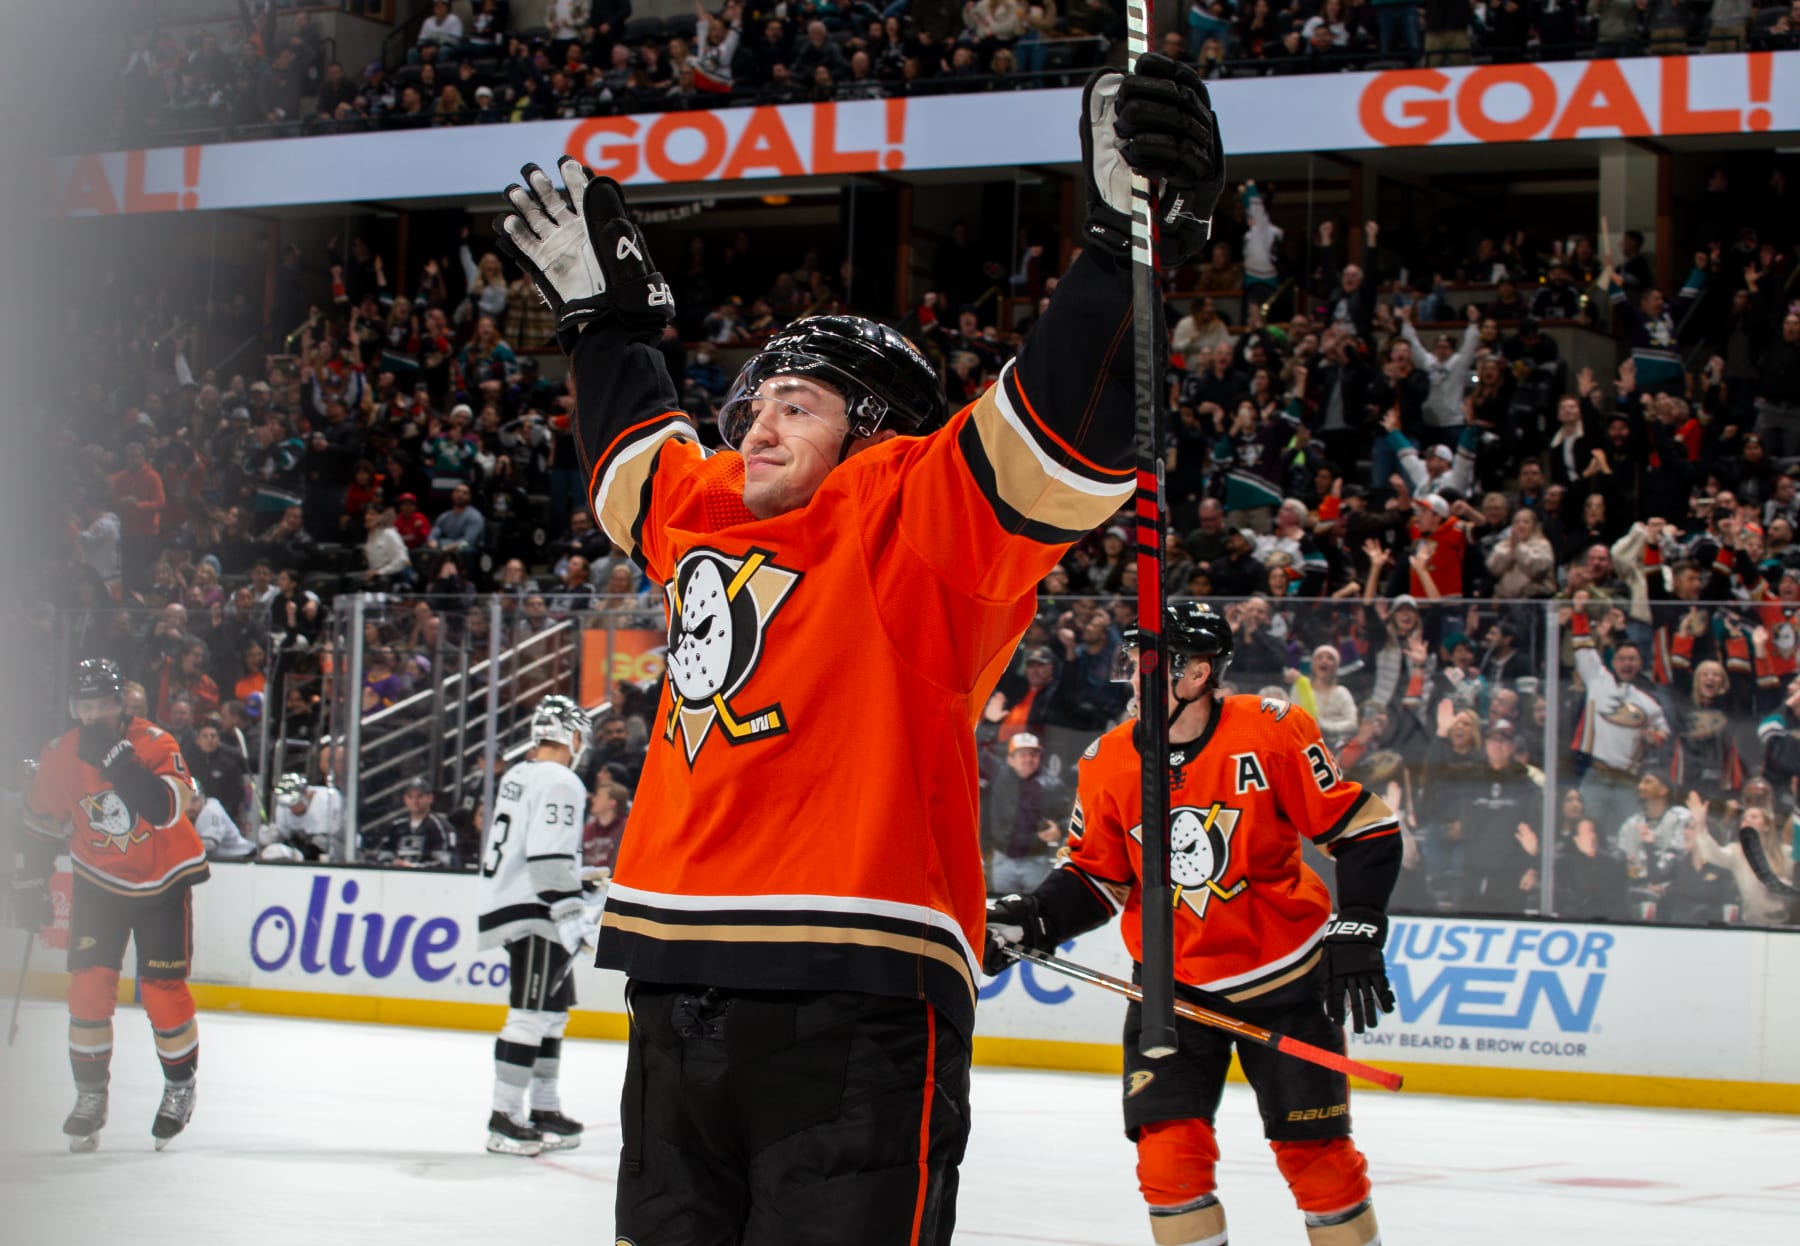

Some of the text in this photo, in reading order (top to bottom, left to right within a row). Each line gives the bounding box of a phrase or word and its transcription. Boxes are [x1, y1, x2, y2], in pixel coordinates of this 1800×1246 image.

[1357, 51, 1774, 148] GOAL!
[564, 98, 907, 184] GOAL!
[1230, 751, 1270, 795] A
[1302, 739, 1343, 793] 3
[545, 803, 575, 826] 33
[1507, 929, 1615, 968] FOR
[1400, 1034, 1455, 1050] BEARD
[1459, 1037, 1471, 1050] &
[1476, 1038, 1526, 1053] BROW
[1529, 1041, 1587, 1057] COLOR
[1287, 1103, 1347, 1122] BAUER
